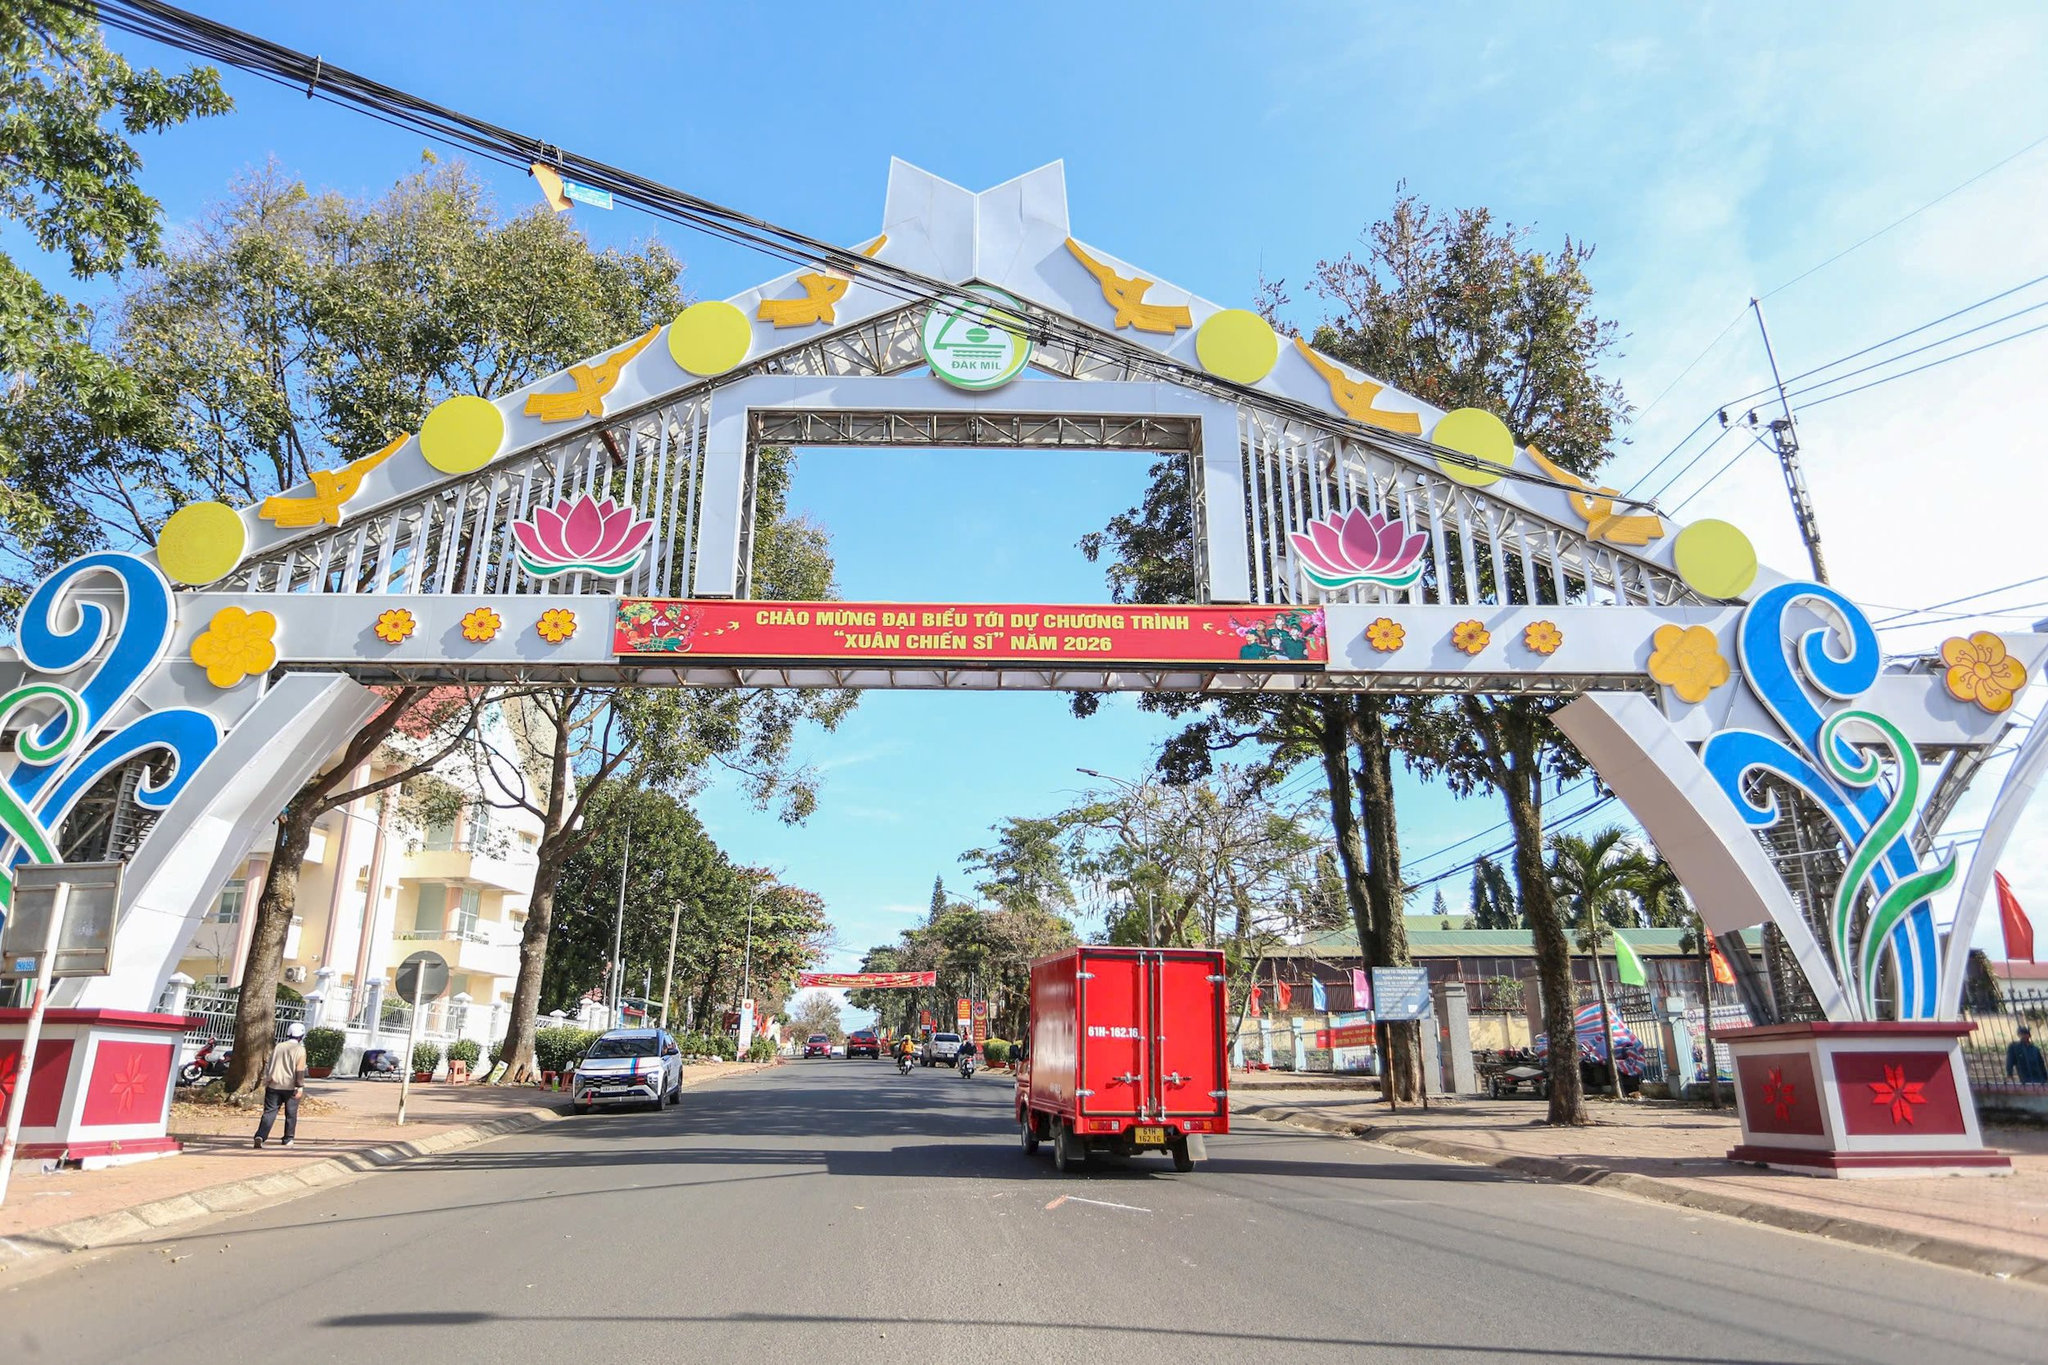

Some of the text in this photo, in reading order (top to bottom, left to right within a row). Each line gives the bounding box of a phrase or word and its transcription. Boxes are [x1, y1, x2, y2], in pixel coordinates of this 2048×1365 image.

[755, 607, 1190, 632] CHÀO MỪNG ĐẠI BIỂU TỚI DỰ CHƯƠNG TRÌNH
[905, 630, 967, 650] CHIẾN
[1010, 633, 1058, 651] NĂM
[1063, 636, 1112, 651] 2026
